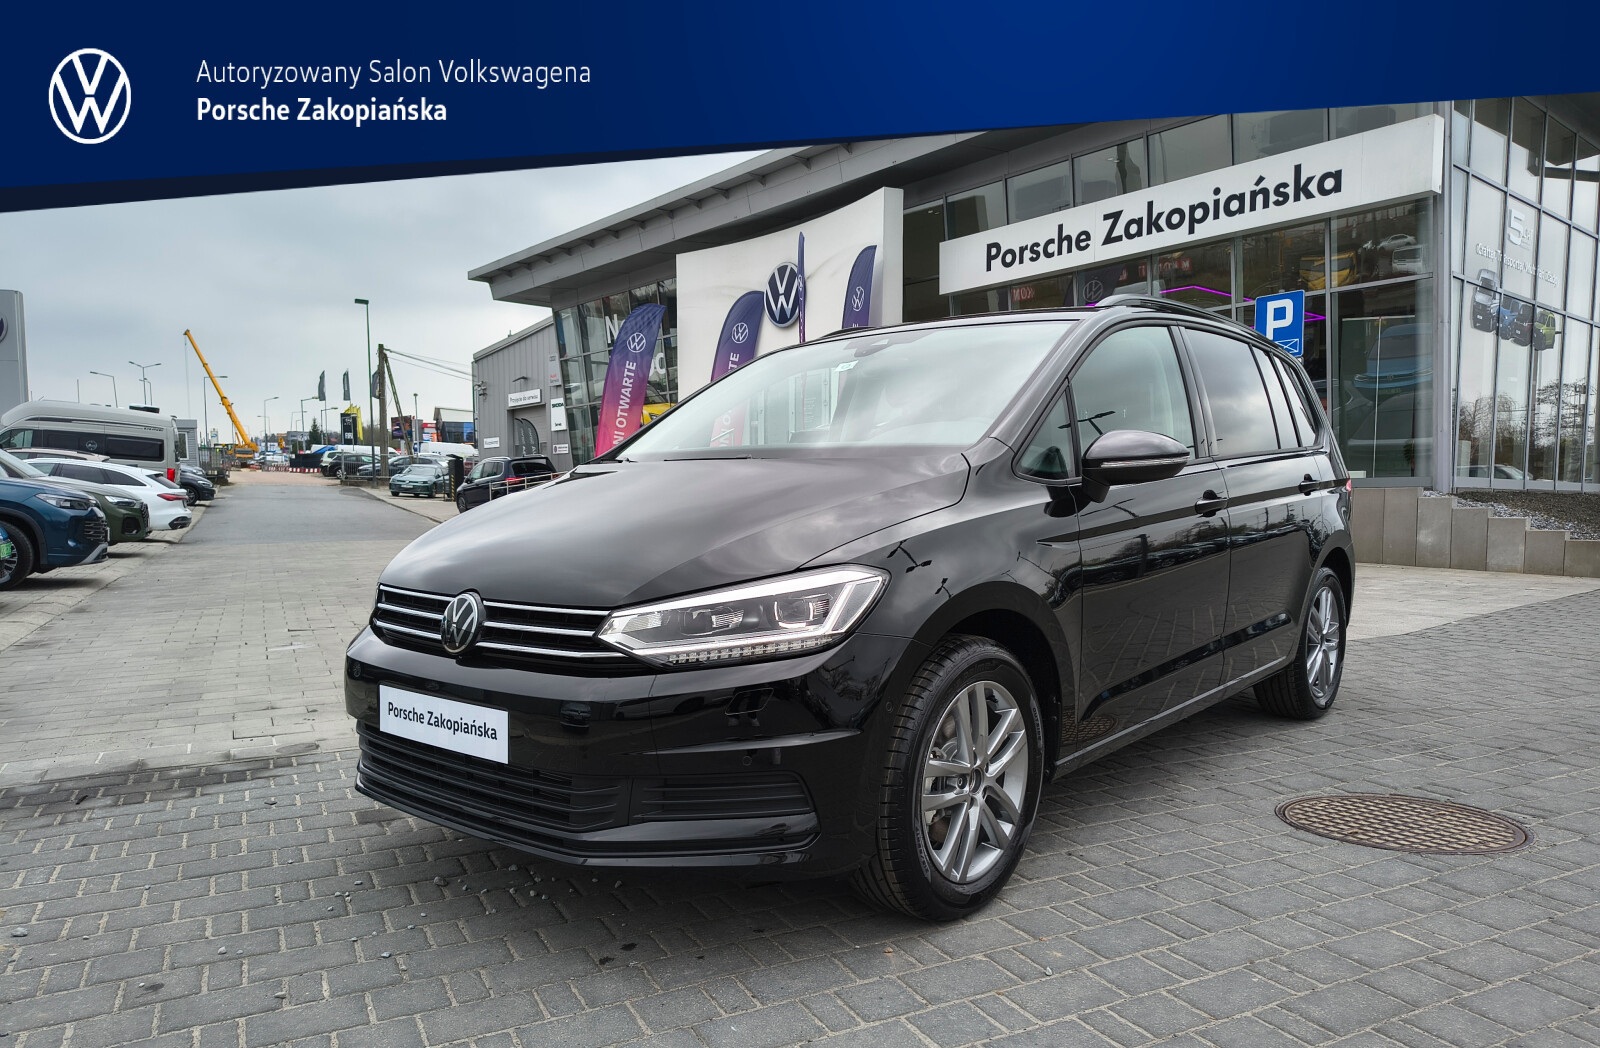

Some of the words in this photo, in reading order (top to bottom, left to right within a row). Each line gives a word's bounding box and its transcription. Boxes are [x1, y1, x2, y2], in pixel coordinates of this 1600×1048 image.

[986, 224, 1091, 272] Porsche
[1101, 163, 1343, 246] Zakopiańska
[1266, 298, 1294, 340] P
[616, 360, 636, 431] OTWARTE
[388, 701, 425, 725] Porsche
[427, 711, 498, 741] Zakopiańska
